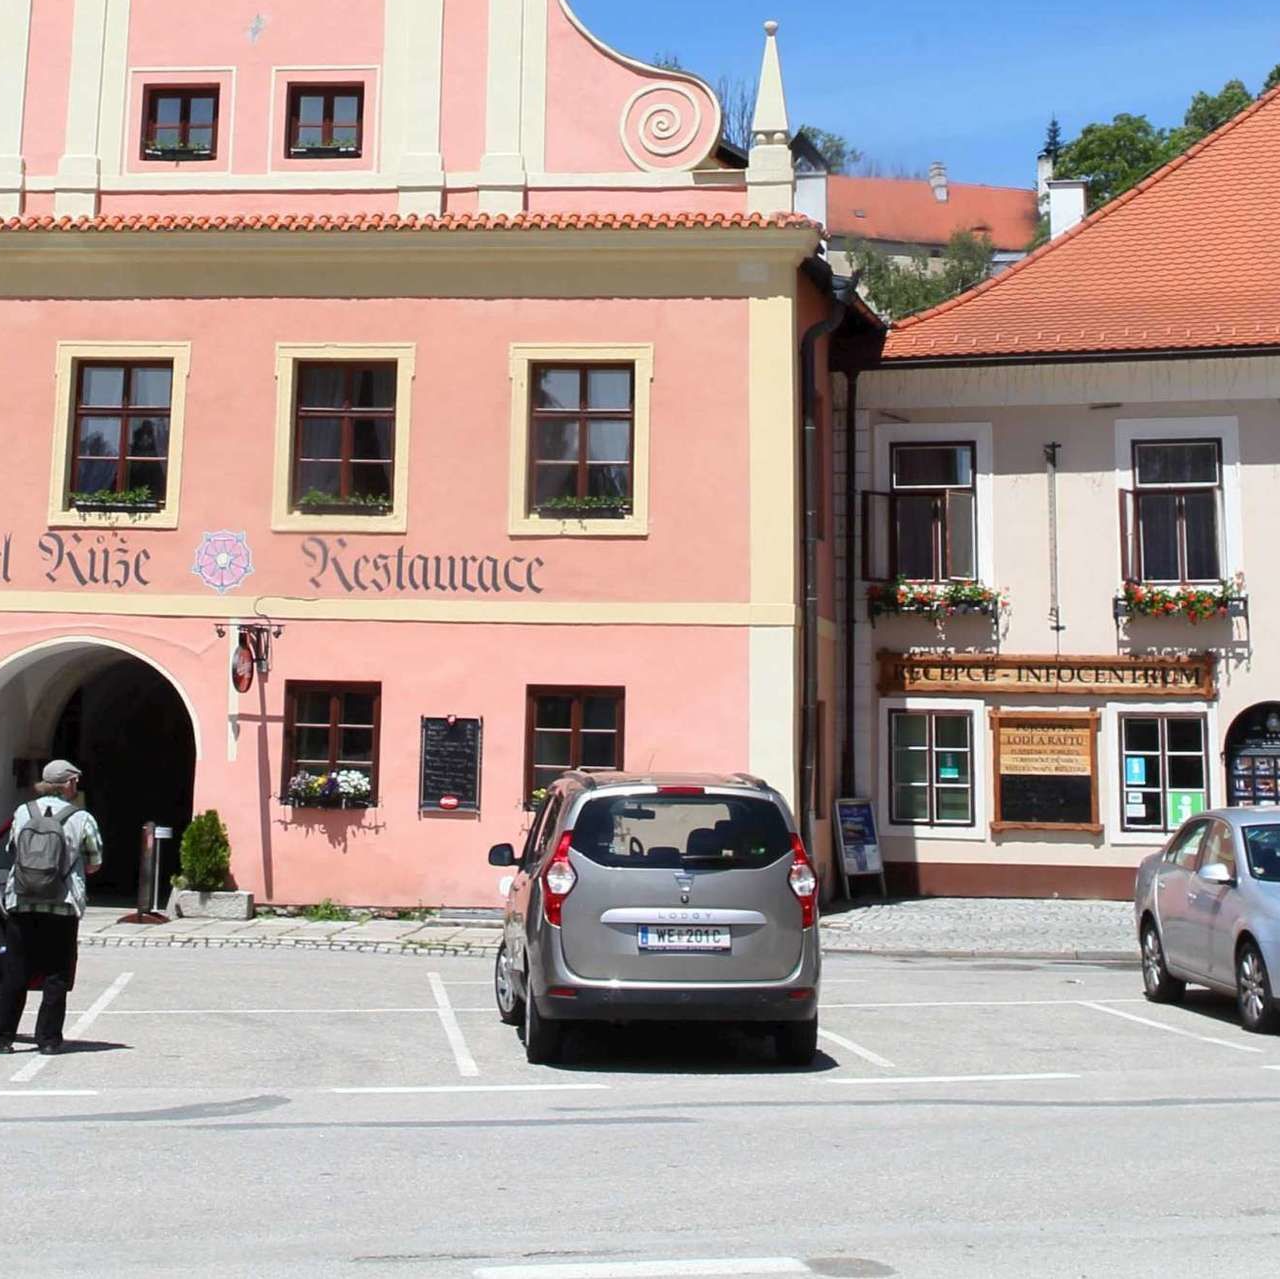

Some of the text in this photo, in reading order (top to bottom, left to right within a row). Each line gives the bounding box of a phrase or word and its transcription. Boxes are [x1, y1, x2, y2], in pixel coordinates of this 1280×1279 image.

[38, 532, 150, 587] Růže
[301, 536, 544, 594] Restaurace
[894, 664, 997, 684] RECEPCE
[1017, 664, 1200, 686] INFOCENTRUM
[656, 928, 721, 944] WE 201C
